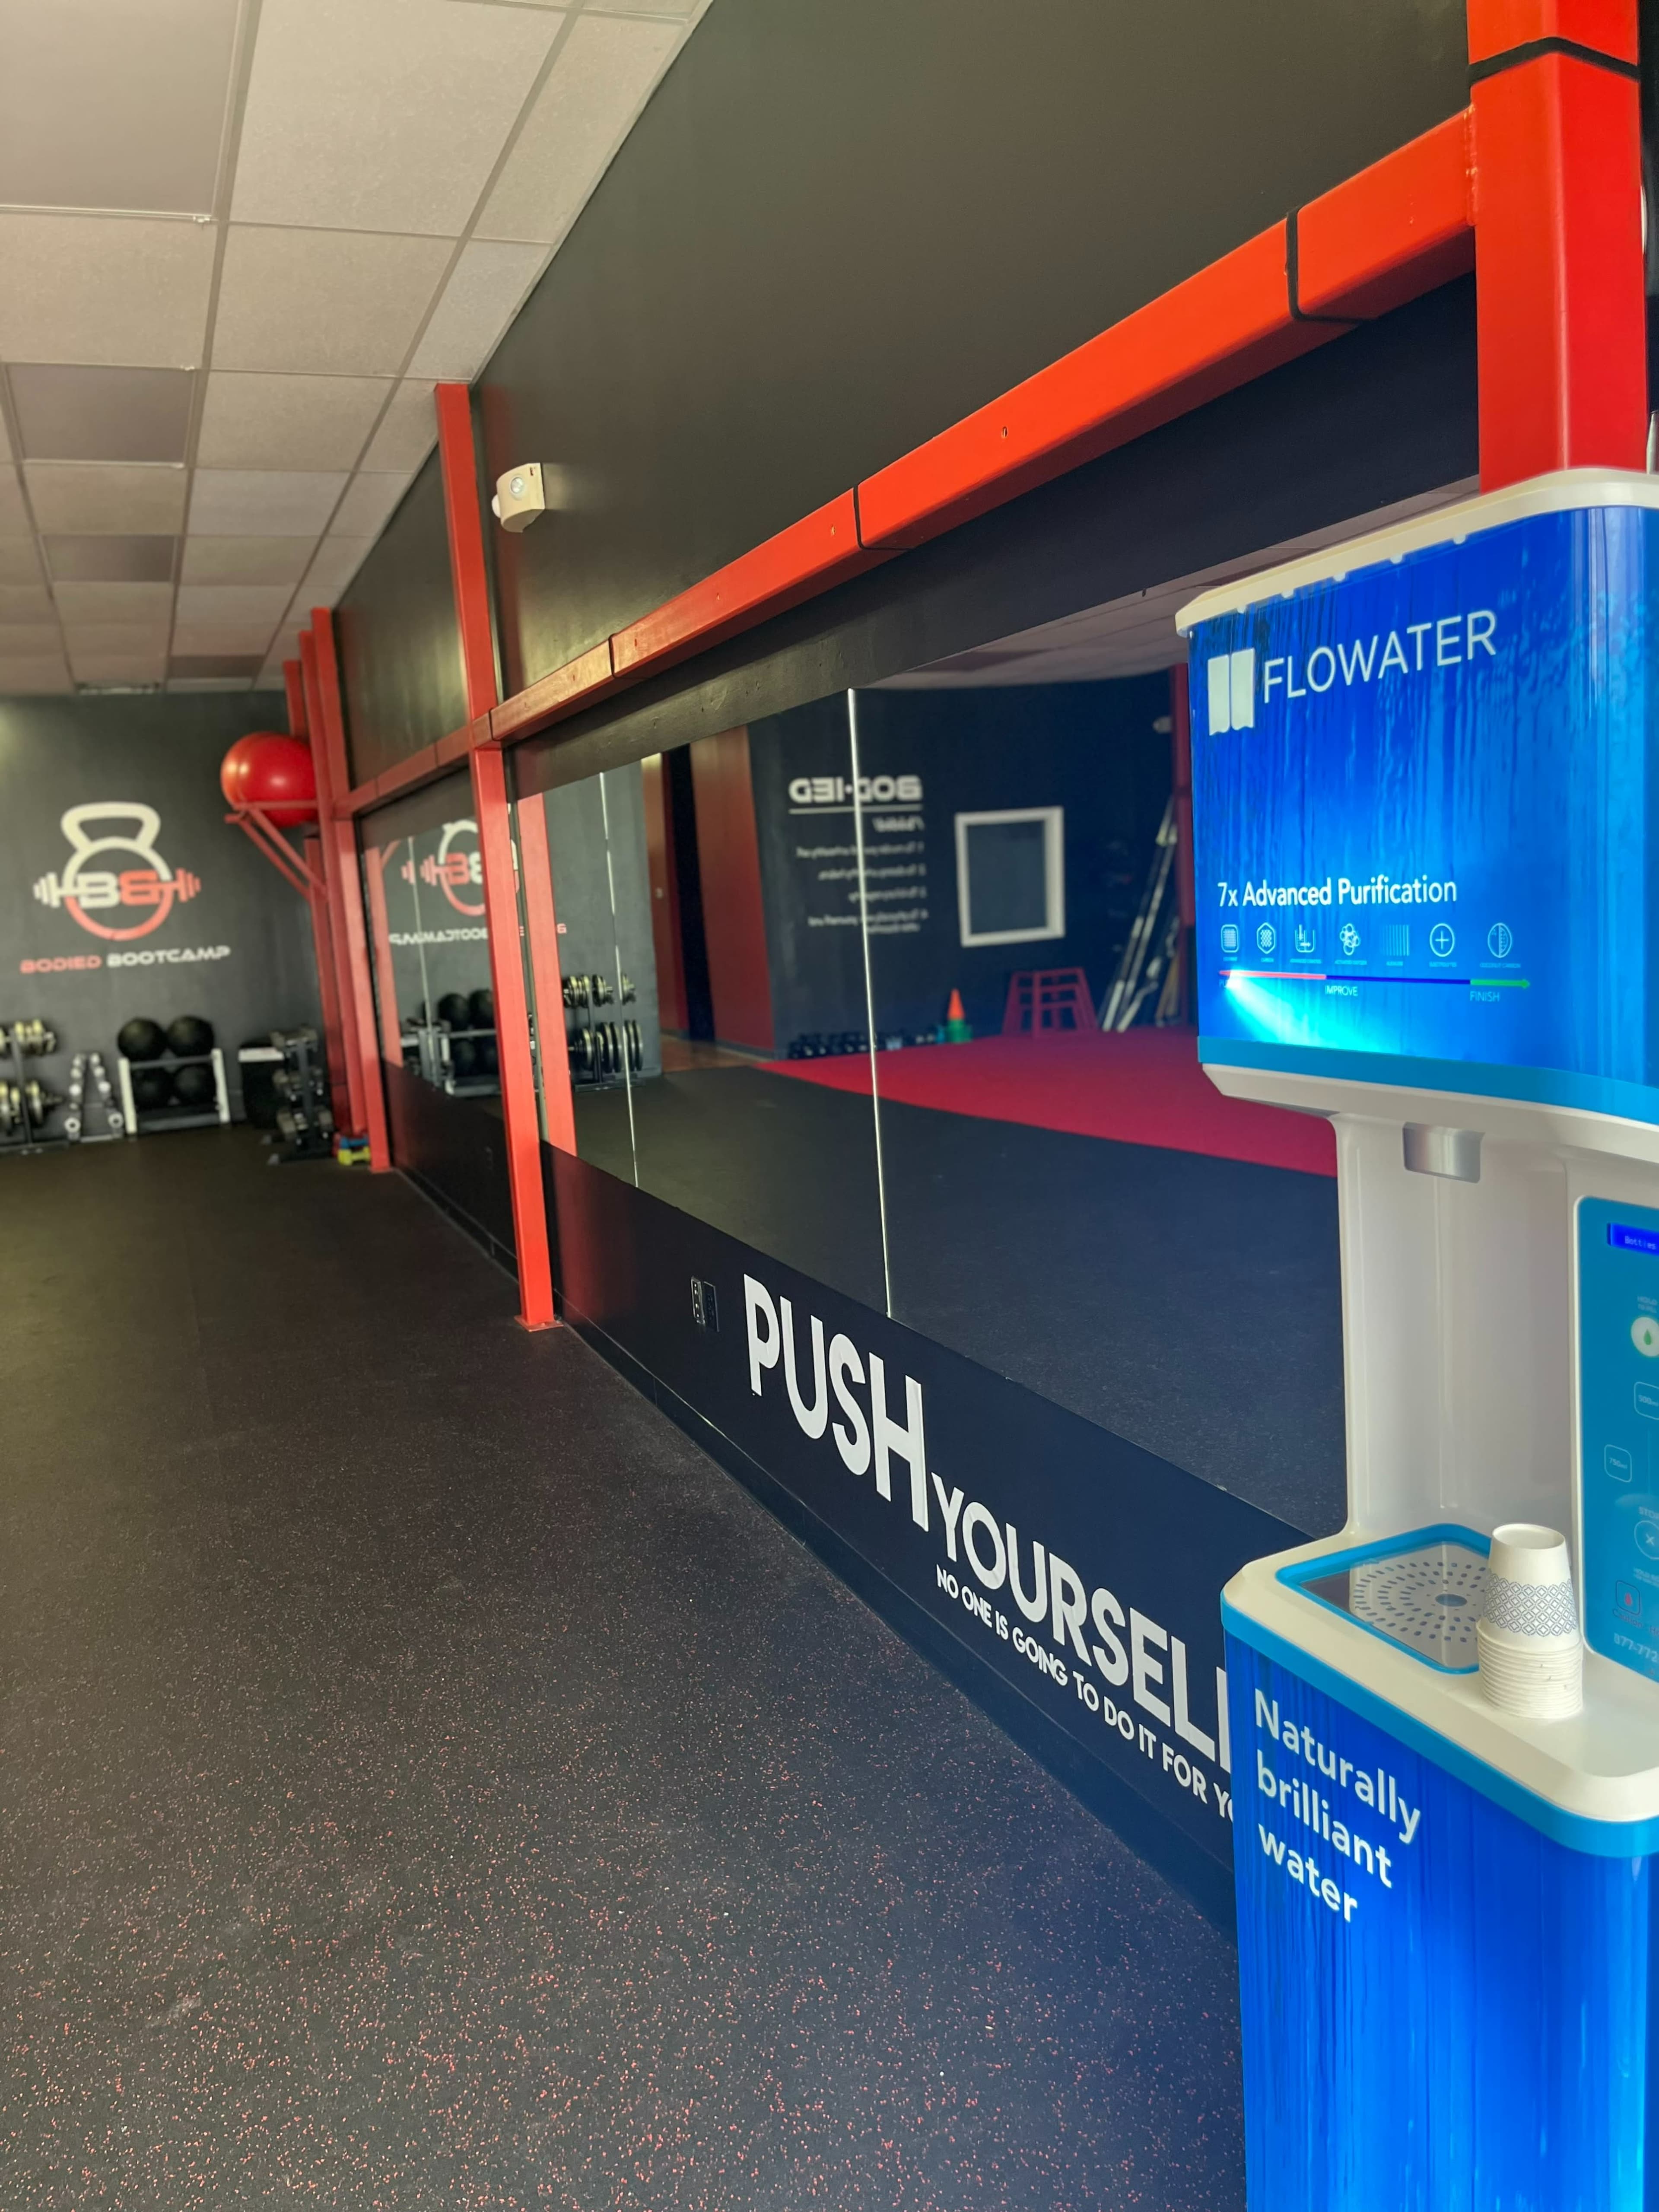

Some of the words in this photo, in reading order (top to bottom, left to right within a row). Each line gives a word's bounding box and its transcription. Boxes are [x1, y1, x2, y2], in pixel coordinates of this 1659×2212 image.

[1264, 610, 1496, 703] FLOWATER
[1217, 882, 1239, 907] 7x
[1242, 877, 1332, 907] Advanced
[1338, 874, 1457, 905] Purification
[20, 955, 102, 973] BODIED
[107, 946, 231, 967] BOOTCAMP
[1325, 985, 1358, 997] IMPROVE
[1470, 991, 1500, 1002] FINISH
[744, 1274, 929, 1532] PUSH
[936, 1564, 959, 1599] NO
[961, 1586, 992, 1628] ONE
[995, 1610, 1009, 1641] IS
[1013, 1626, 1068, 1687] GOING
[1072, 1670, 1099, 1712] TO
[1104, 1695, 1135, 1740] DO
[1138, 1723, 1157, 1760] IT
[1162, 1742, 1208, 1805] FOR
[1255, 1688, 1421, 1844] Naturally
[1257, 1749, 1392, 1888] brilliant
[1258, 1823, 1357, 1923] water
